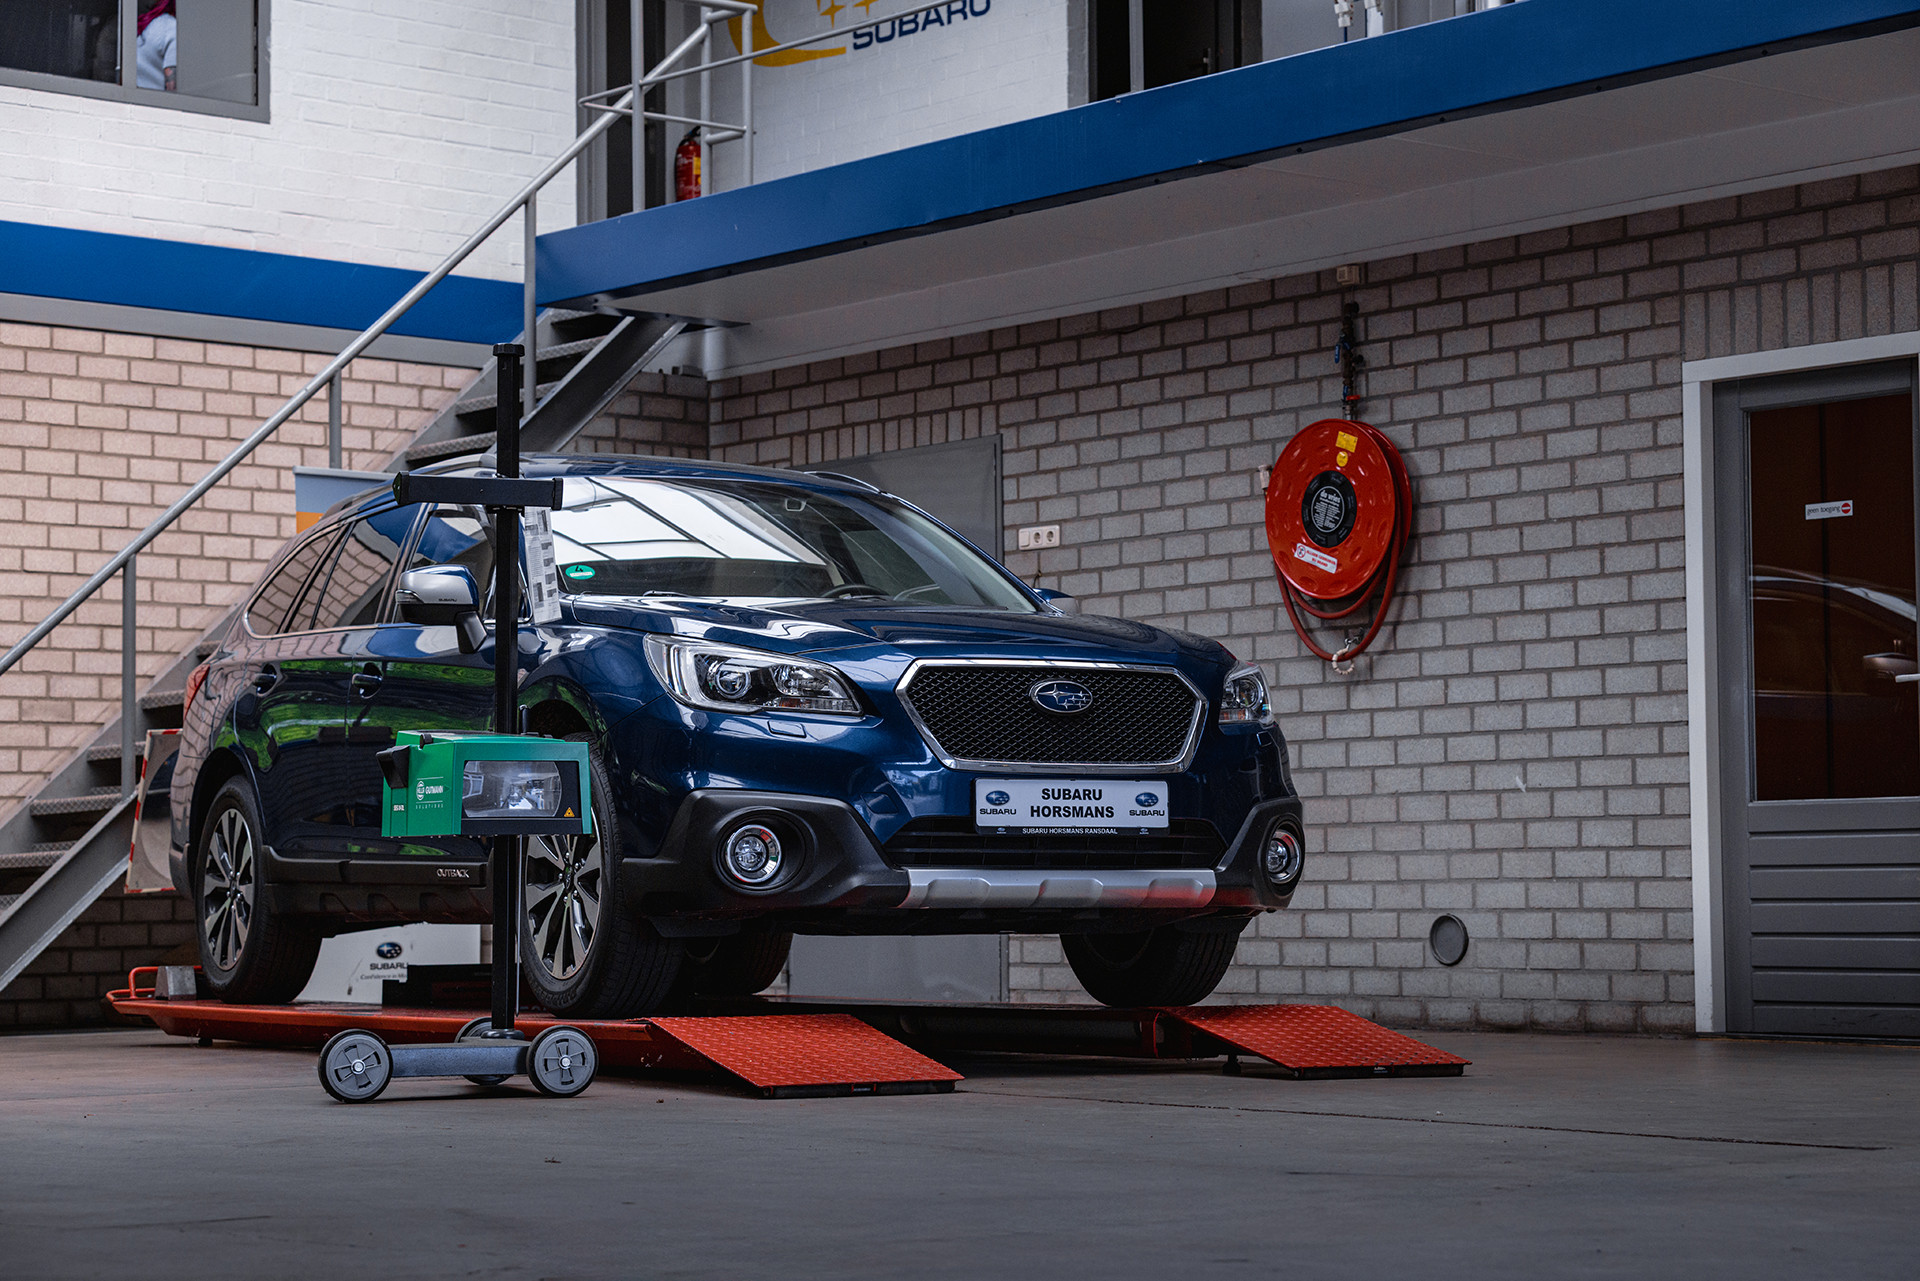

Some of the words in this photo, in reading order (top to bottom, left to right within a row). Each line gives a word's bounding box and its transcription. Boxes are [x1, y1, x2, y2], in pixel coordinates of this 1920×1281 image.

[853, 0, 991, 50] SUBARU
[1807, 508, 1819, 516] geen
[1820, 506, 1840, 514] toegang
[1041, 788, 1103, 801] SUBARU
[1030, 805, 1115, 818] HORSMANS
[1129, 809, 1166, 817] SUBARU
[436, 868, 470, 878] OUTBACK
[370, 962, 409, 971] SUBARU
